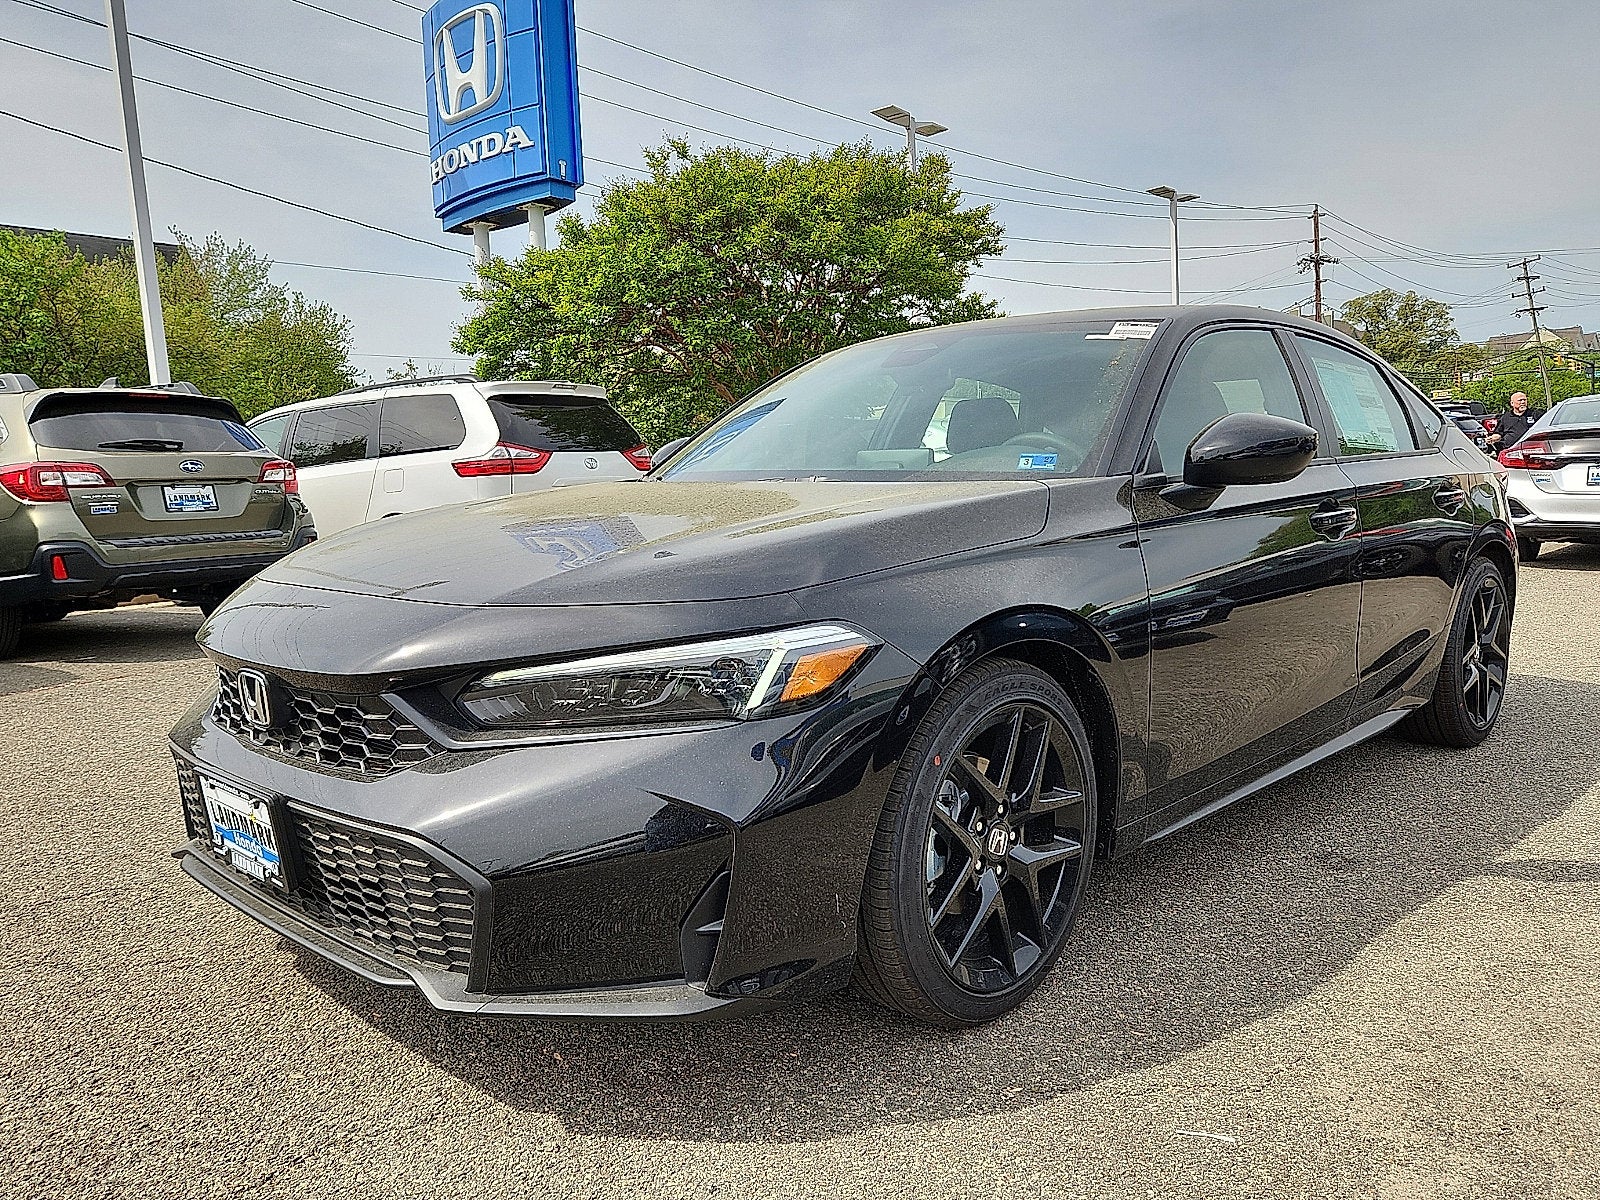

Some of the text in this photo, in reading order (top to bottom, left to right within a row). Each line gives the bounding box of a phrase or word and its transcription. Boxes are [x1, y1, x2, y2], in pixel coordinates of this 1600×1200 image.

[431, 126, 535, 185] HONDA
[1023, 458, 1030, 466] 3
[168, 494, 212, 502] LANDMARK
[985, 681, 1026, 700] EAGLE
[209, 800, 278, 853] LANDMARK
[233, 830, 264, 858] Honda
